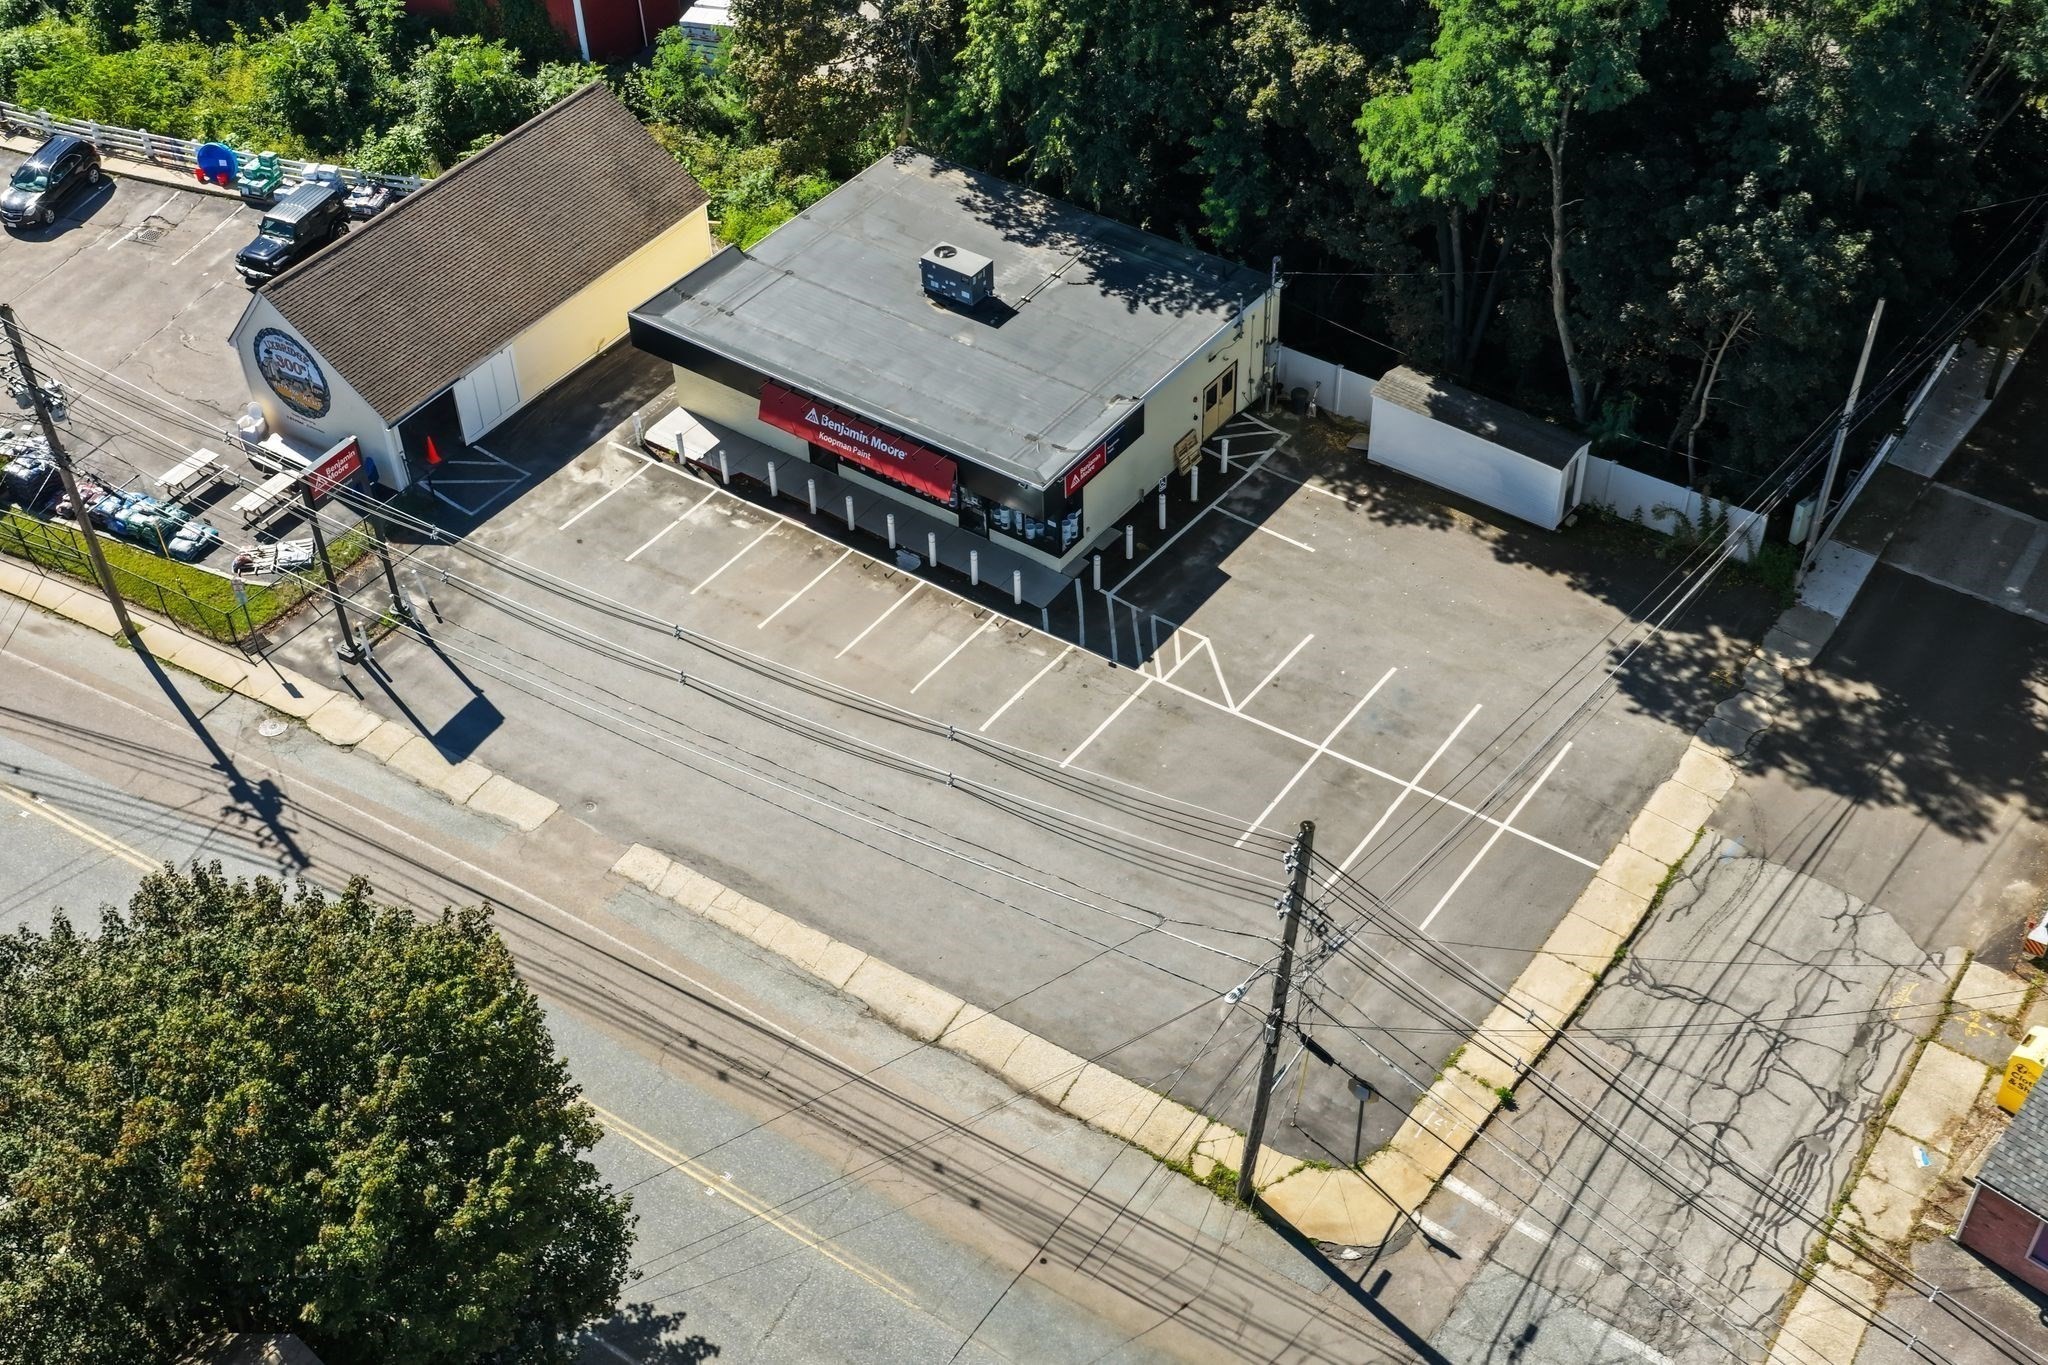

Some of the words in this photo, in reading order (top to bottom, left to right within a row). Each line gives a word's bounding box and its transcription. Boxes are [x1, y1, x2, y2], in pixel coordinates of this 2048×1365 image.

[818, 431, 852, 452] Koopman
[852, 446, 871, 460] Paint
[821, 414, 869, 444] Benjamin
[871, 436, 905, 460] Moore
[325, 450, 356, 475] Benjamin
[327, 463, 349, 479] Moore
